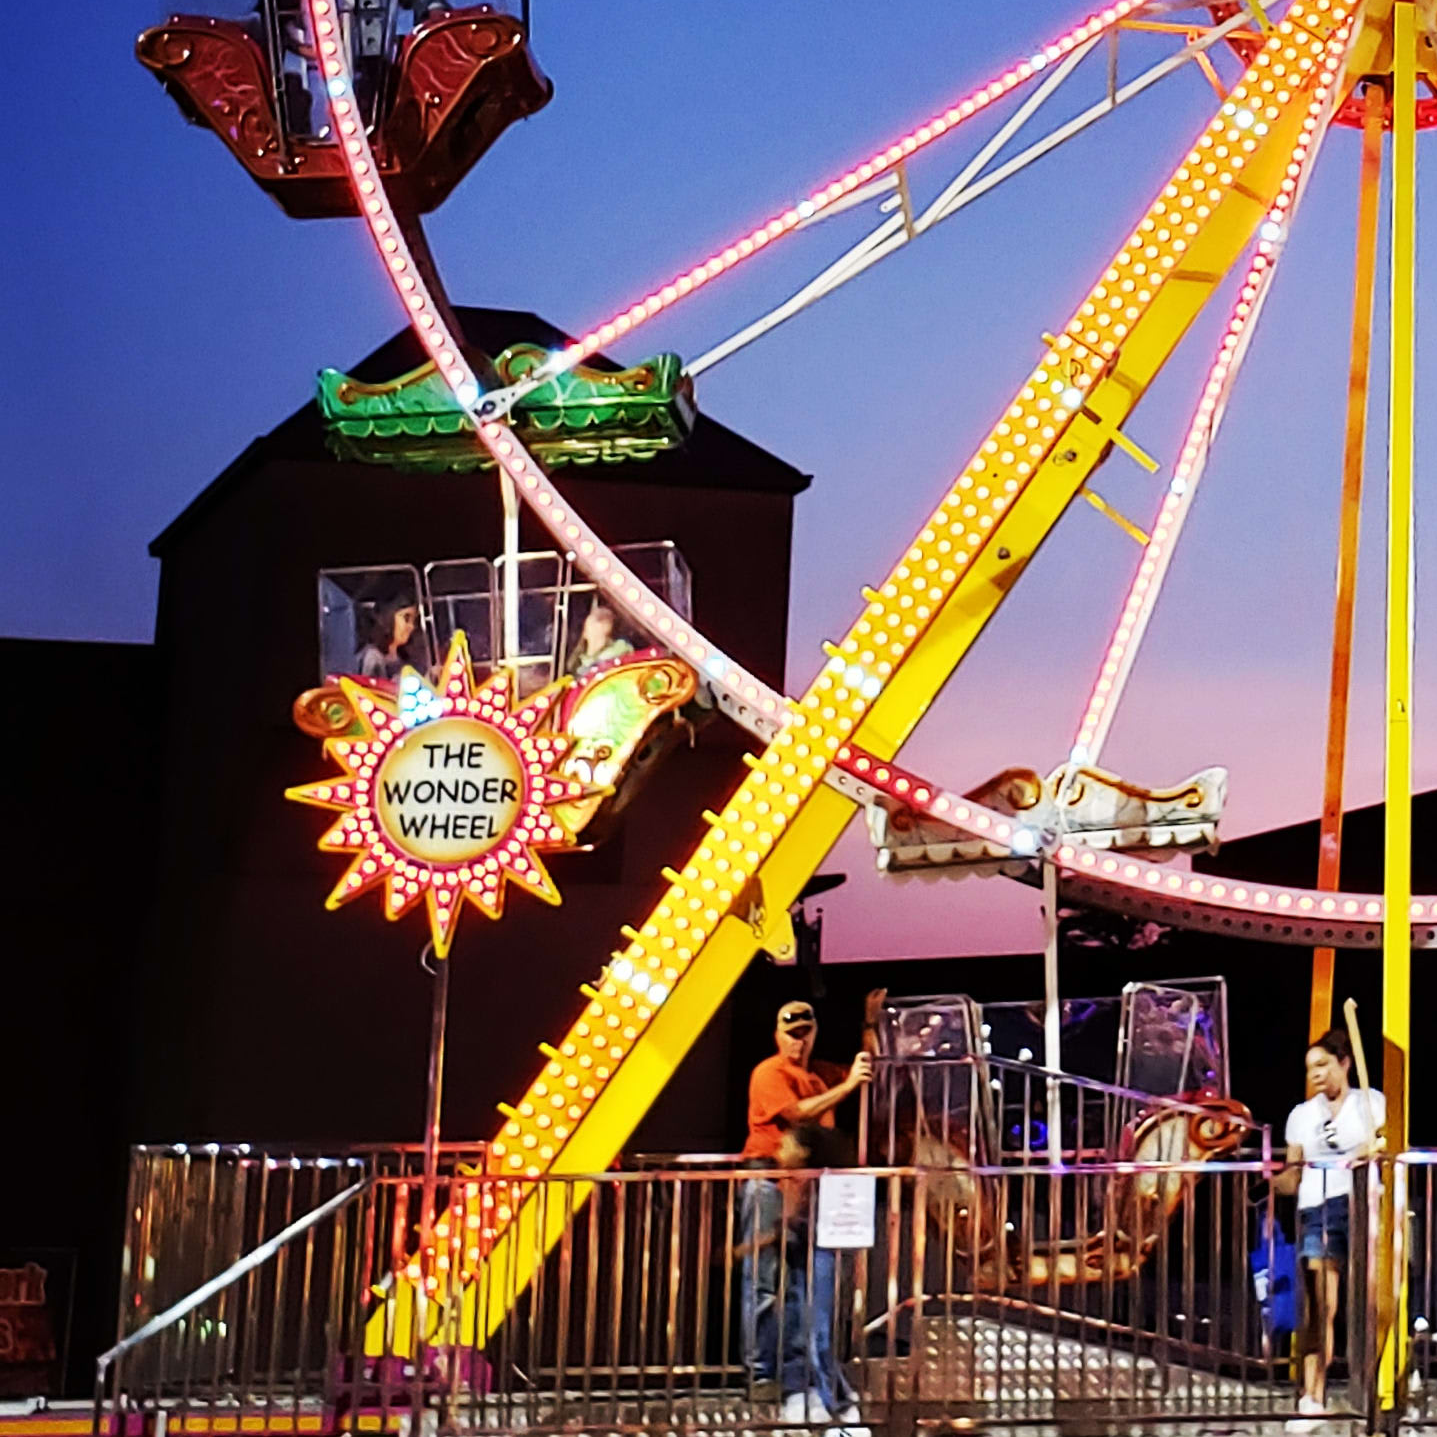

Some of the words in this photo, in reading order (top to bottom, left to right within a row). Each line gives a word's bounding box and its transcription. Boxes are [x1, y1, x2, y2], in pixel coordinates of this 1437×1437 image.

[422, 743, 485, 769] THE
[383, 778, 518, 805] WONDER
[400, 814, 498, 839] WHEEL
